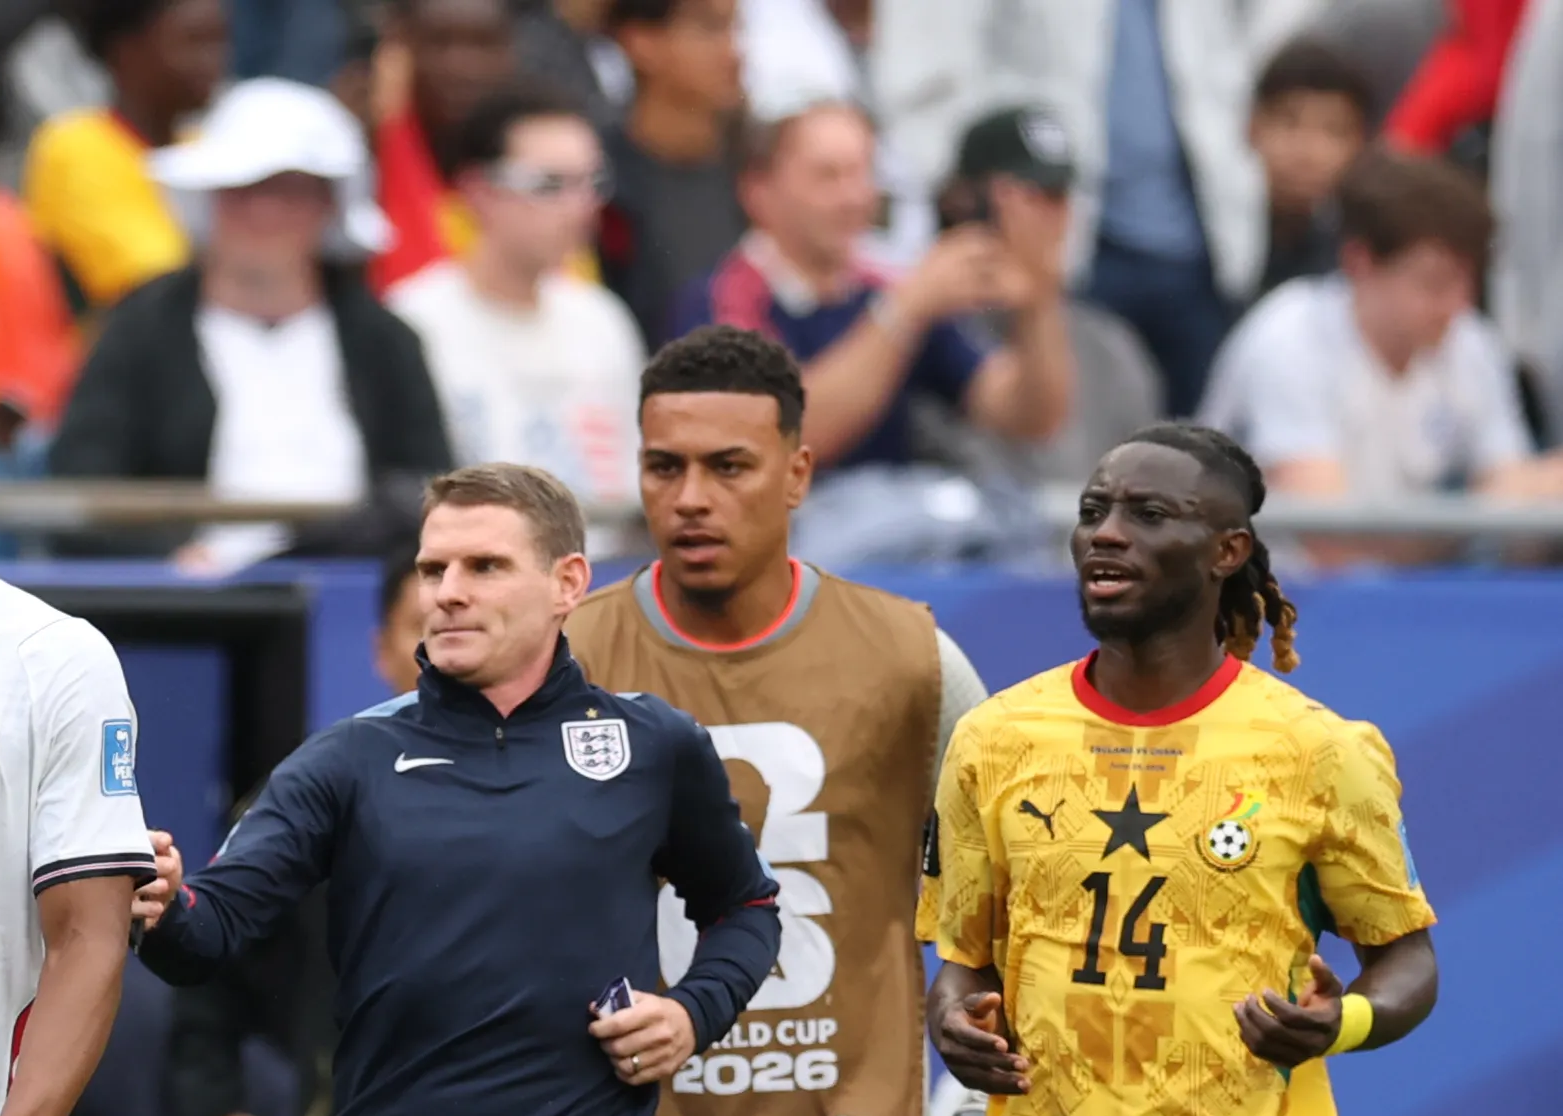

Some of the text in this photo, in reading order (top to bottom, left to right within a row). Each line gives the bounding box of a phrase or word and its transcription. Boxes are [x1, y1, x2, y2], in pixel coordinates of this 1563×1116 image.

[1072, 872, 1168, 991] 14
[776, 1018, 837, 1046] CUP
[672, 1049, 839, 1095] 2026
